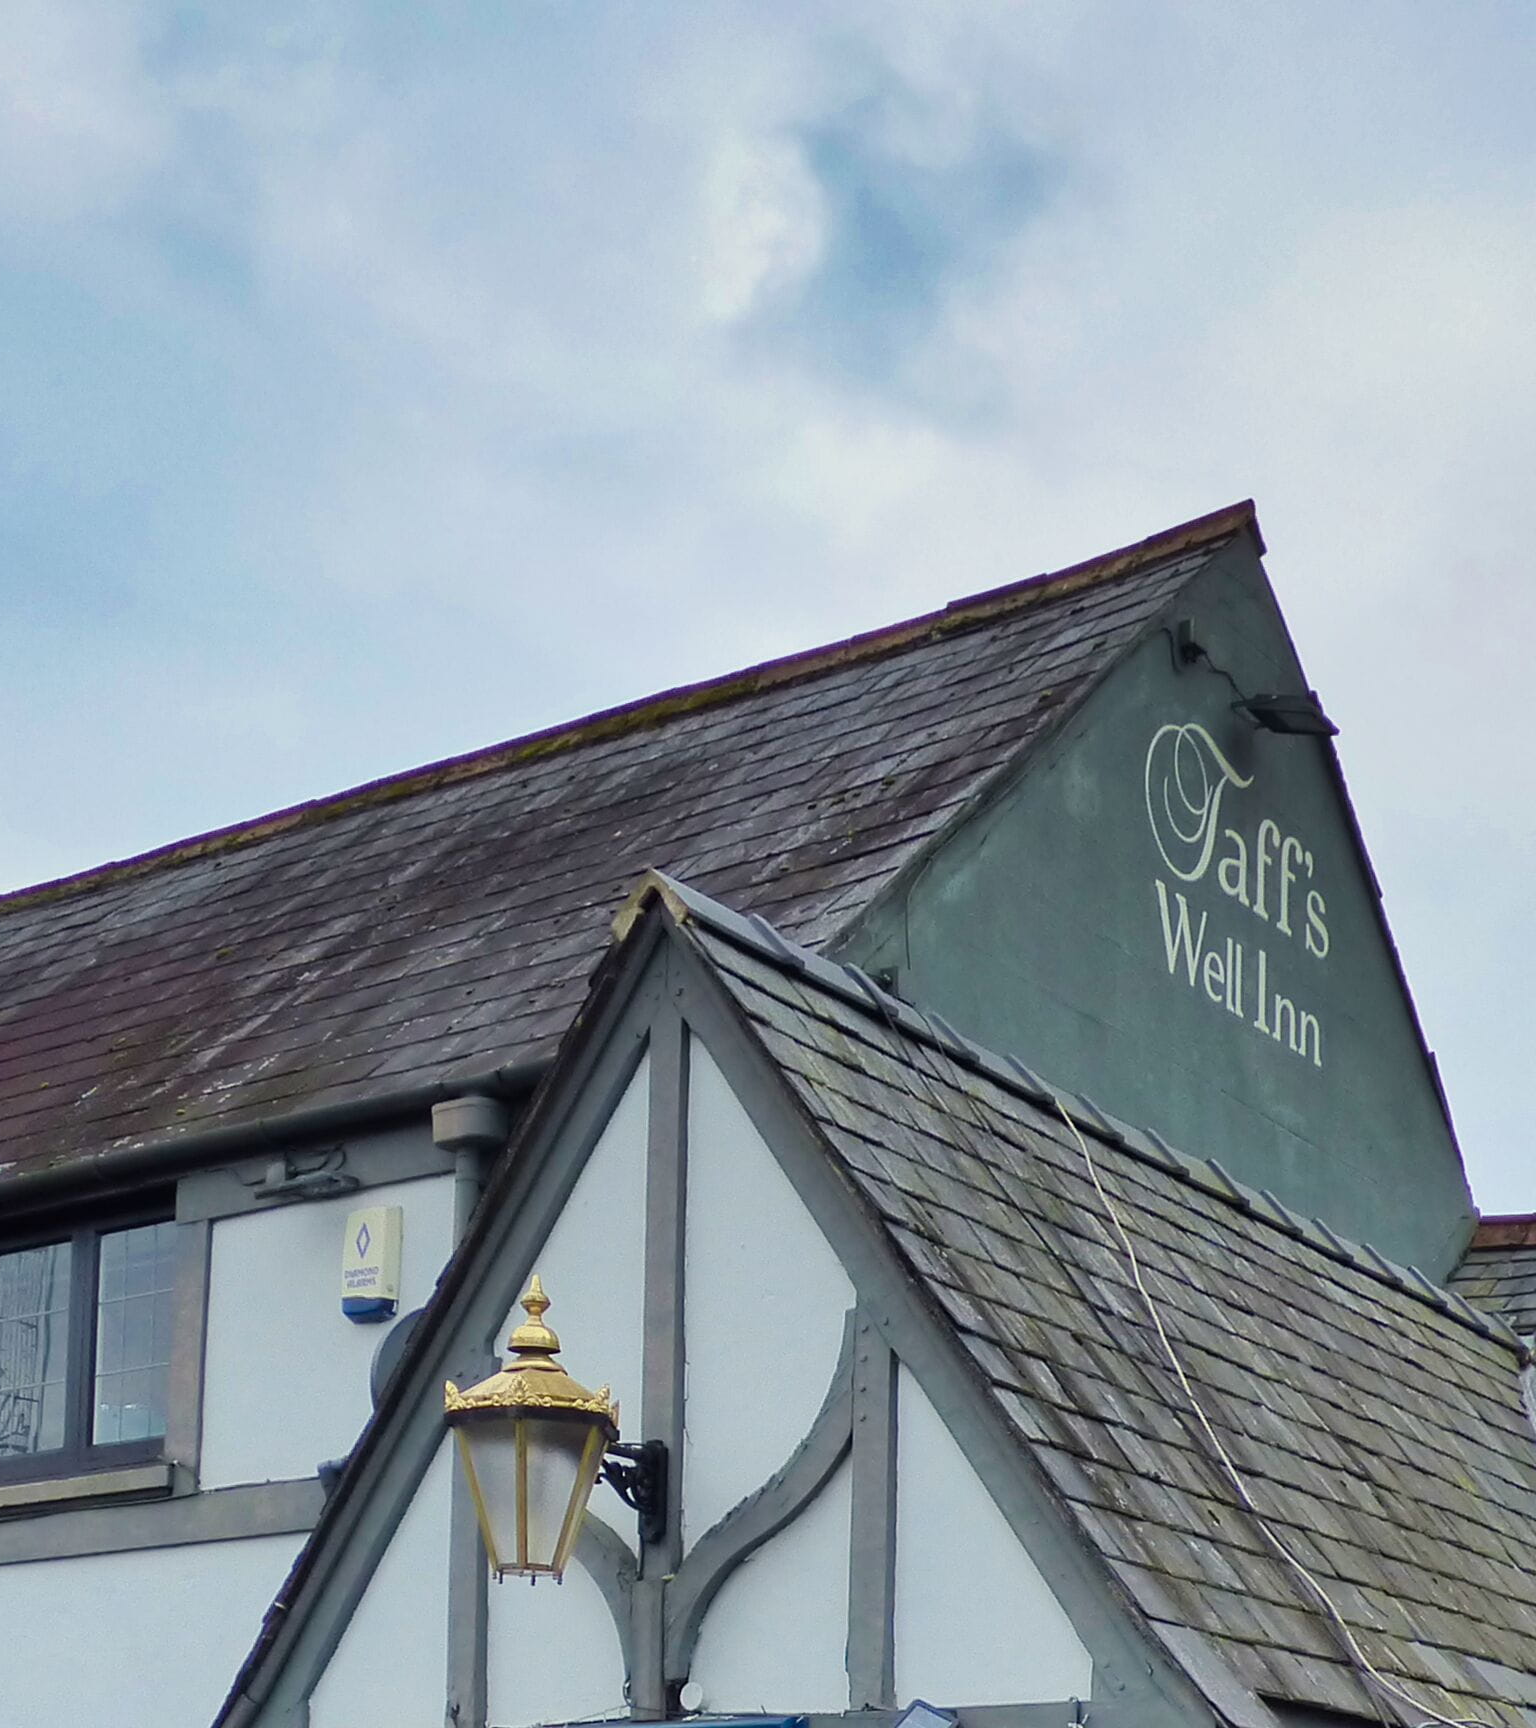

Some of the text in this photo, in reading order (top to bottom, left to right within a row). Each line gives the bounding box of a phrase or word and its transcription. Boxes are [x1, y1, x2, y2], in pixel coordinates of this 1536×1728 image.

[1145, 722, 1331, 958] Taff's
[1155, 878, 1322, 1067] Well Inn
